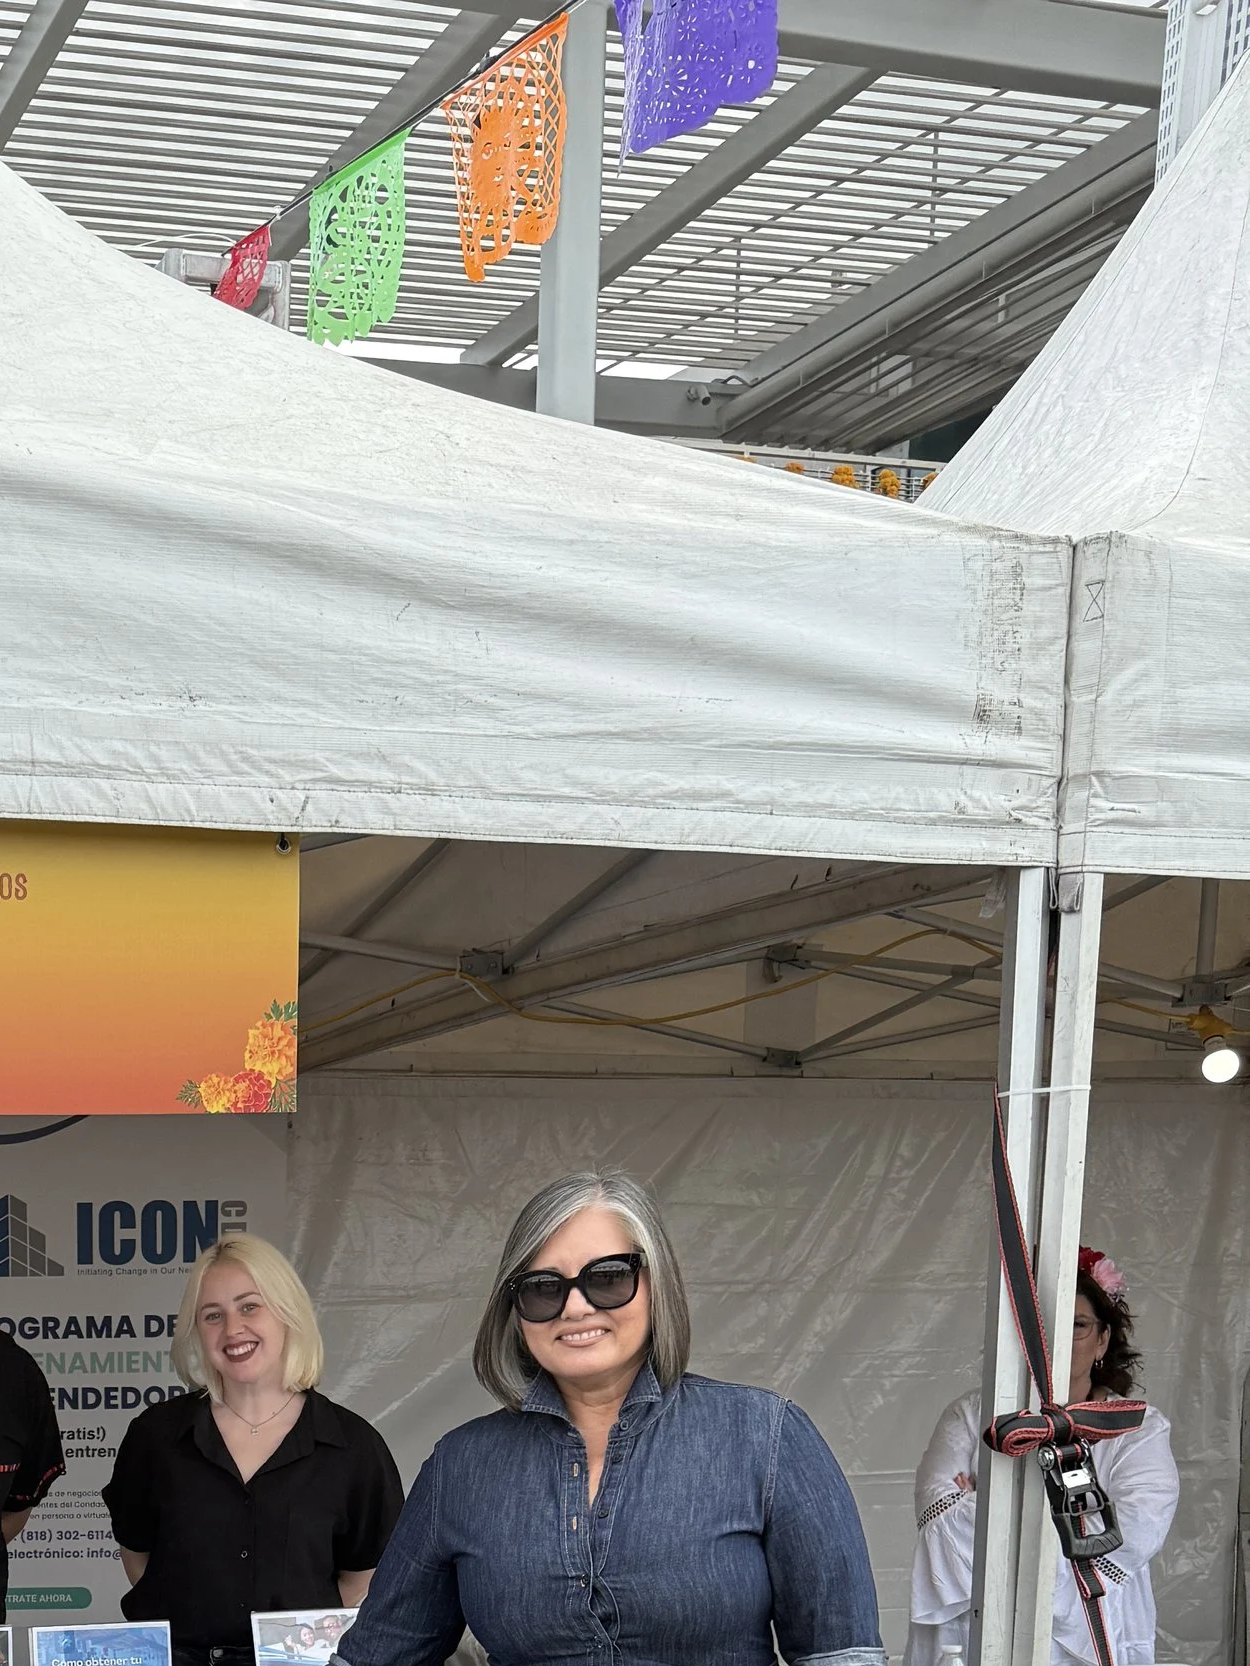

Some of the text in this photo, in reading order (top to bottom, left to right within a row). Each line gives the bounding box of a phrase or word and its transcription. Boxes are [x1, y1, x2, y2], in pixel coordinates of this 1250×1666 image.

[76, 1199, 219, 1266] ICON
[77, 1267, 113, 1277] Initiating
[116, 1267, 148, 1277] Change
[150, 1267, 158, 1275] in
[160, 1267, 176, 1275] Our
[60, 1426, 106, 1442] ratis!)
[42, 1512, 74, 1520] persona
[21, 1529, 113, 1543] (818) 302-6114
[40, 1594, 73, 1603] AHORA
[86, 1656, 128, 1666] obtener
[130, 1656, 142, 1664] tu
